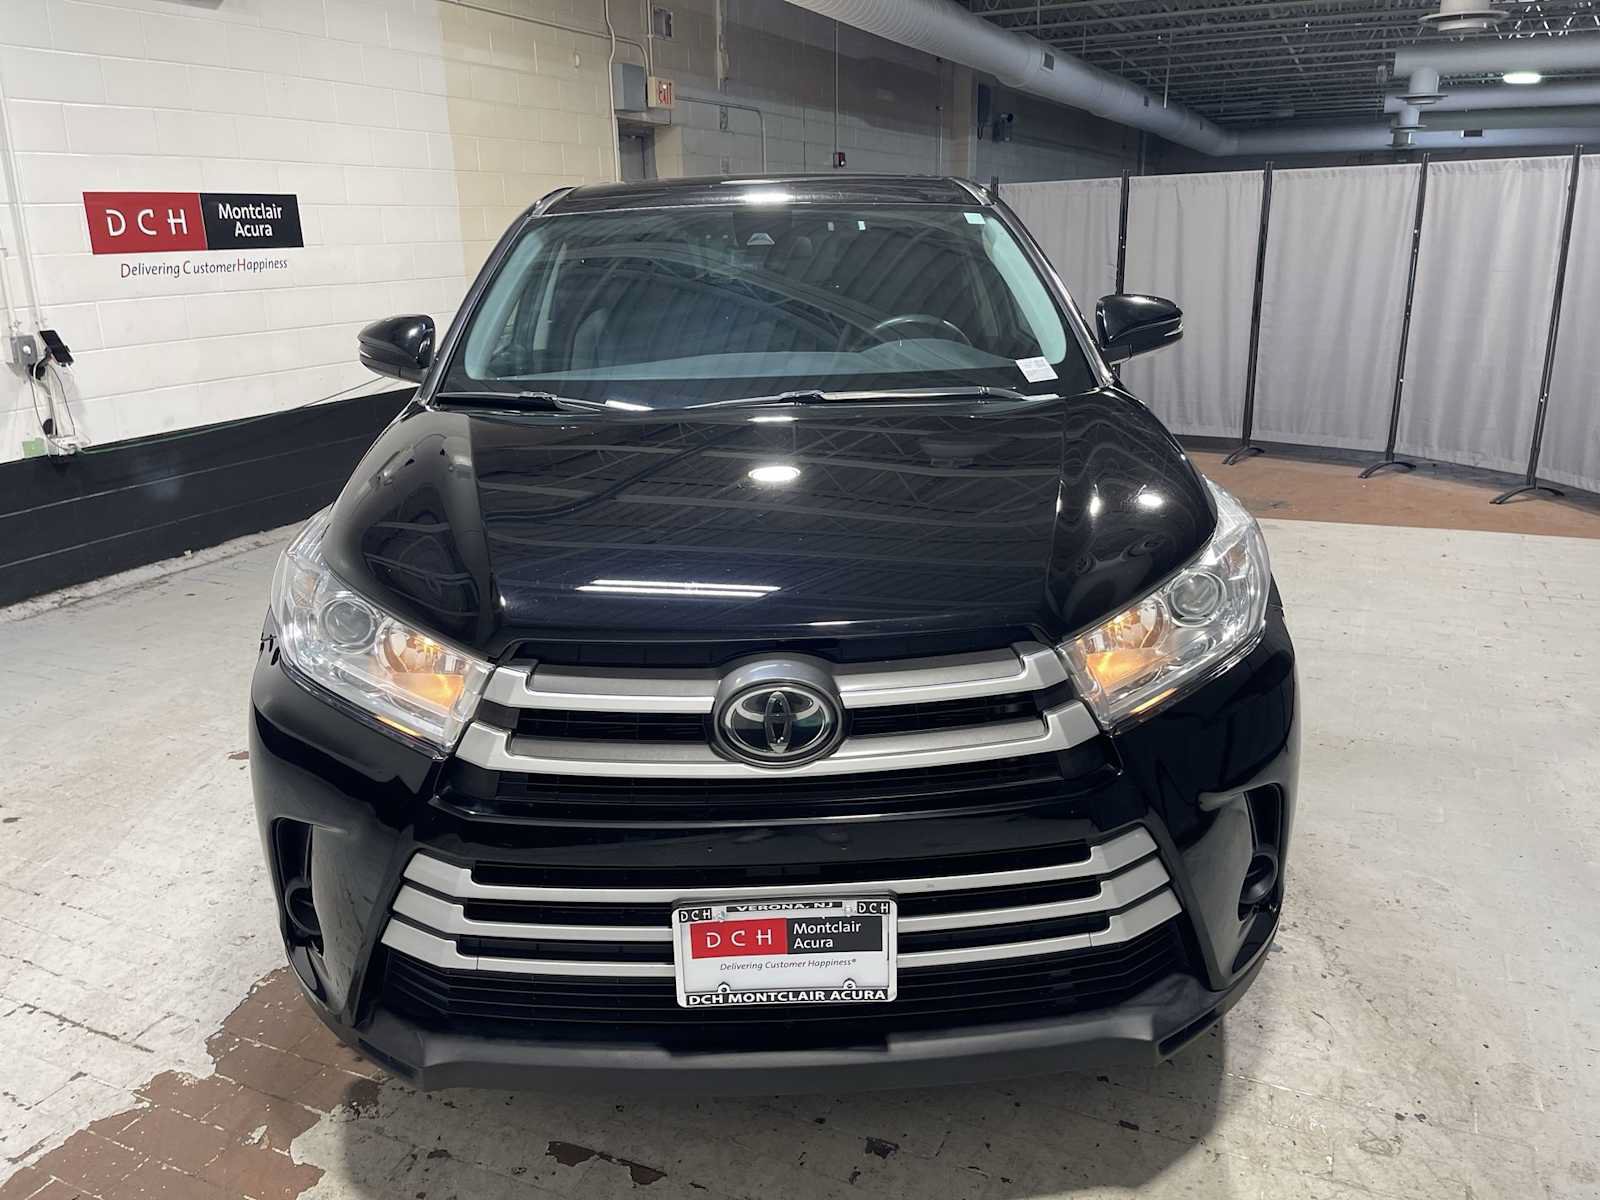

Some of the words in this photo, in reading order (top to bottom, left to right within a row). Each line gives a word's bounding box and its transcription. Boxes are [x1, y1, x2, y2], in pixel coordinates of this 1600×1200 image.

[218, 203, 283, 220] Montclair
[234, 221, 273, 238] Acura
[120, 262, 180, 279] Delivering
[736, 902, 811, 912] VERONA,
[857, 901, 890, 914] DCH
[680, 908, 712, 922] DCH
[793, 922, 862, 935] Montclair
[705, 928, 773, 949] DCH
[793, 937, 834, 950] Acura
[720, 962, 763, 972] Delivering
[765, 960, 806, 969] Customer
[688, 994, 725, 1006] DCH
[728, 990, 826, 1005] MONTCLAIR
[829, 990, 886, 1001] ACURA
